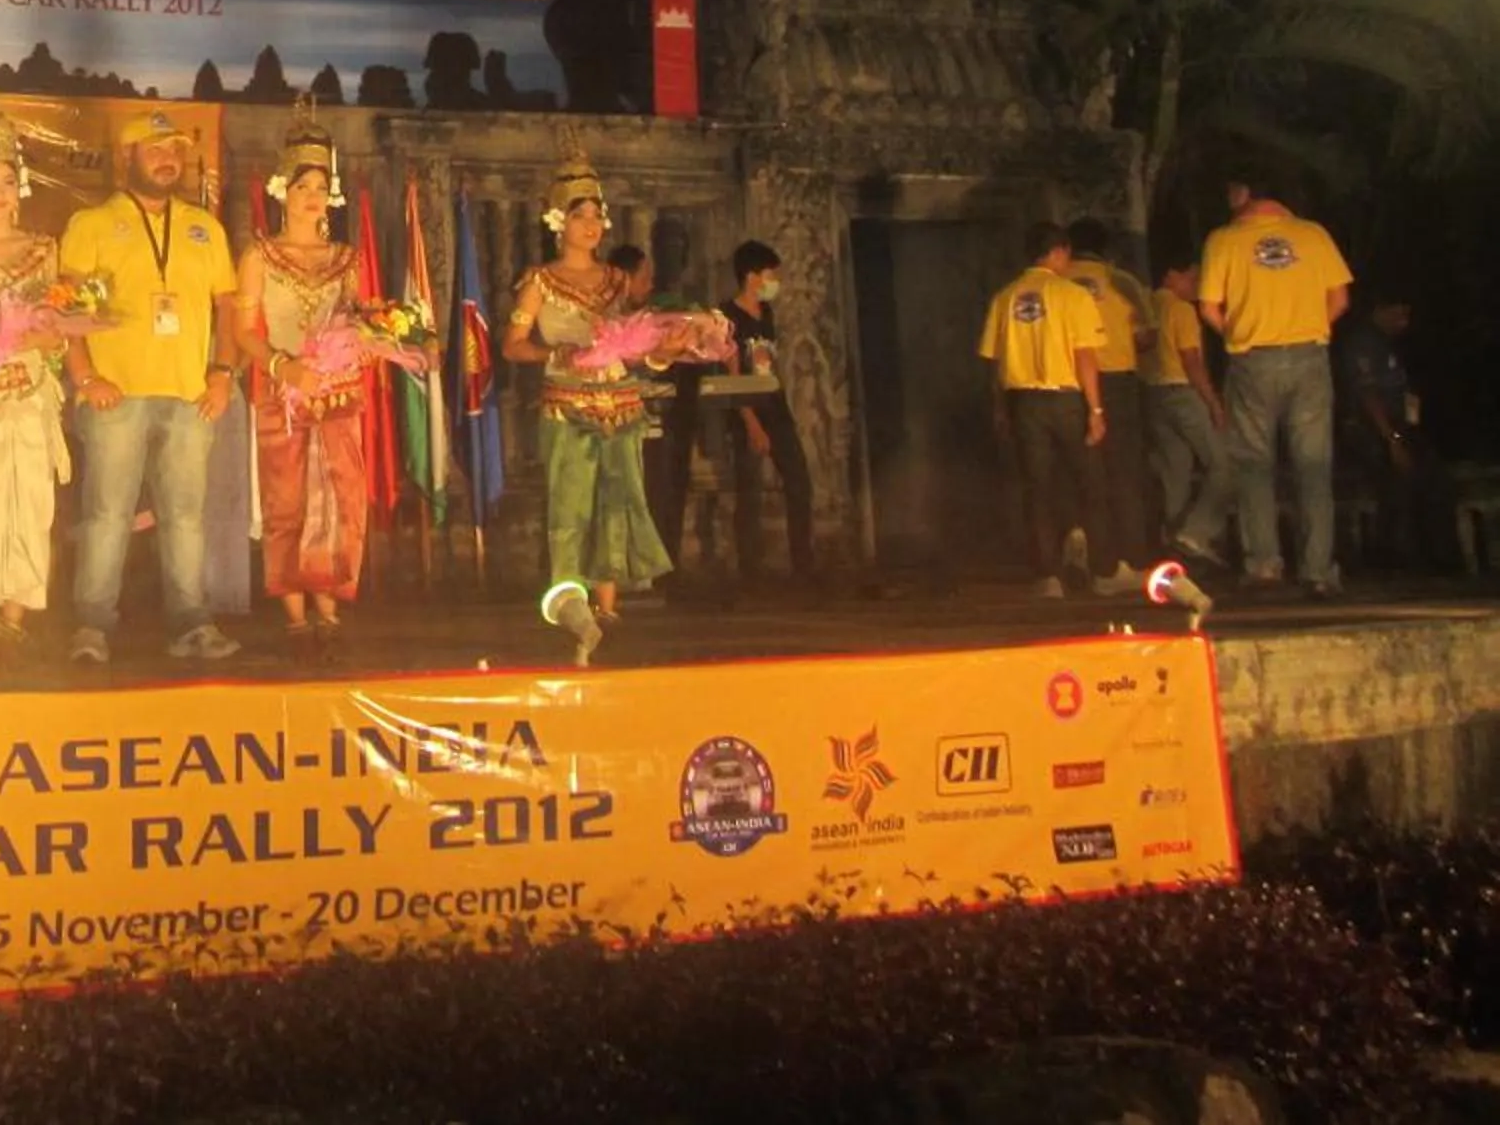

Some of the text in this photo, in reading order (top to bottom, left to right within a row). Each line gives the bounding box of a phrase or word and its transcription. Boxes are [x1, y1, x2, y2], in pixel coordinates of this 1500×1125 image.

[943, 745, 1000, 784] CII
[130, 803, 393, 870] RALLY
[429, 789, 615, 851] 2012
[811, 815, 905, 841] asean india
[26, 900, 270, 949] November
[305, 889, 360, 927] 20
[373, 877, 587, 923] December
